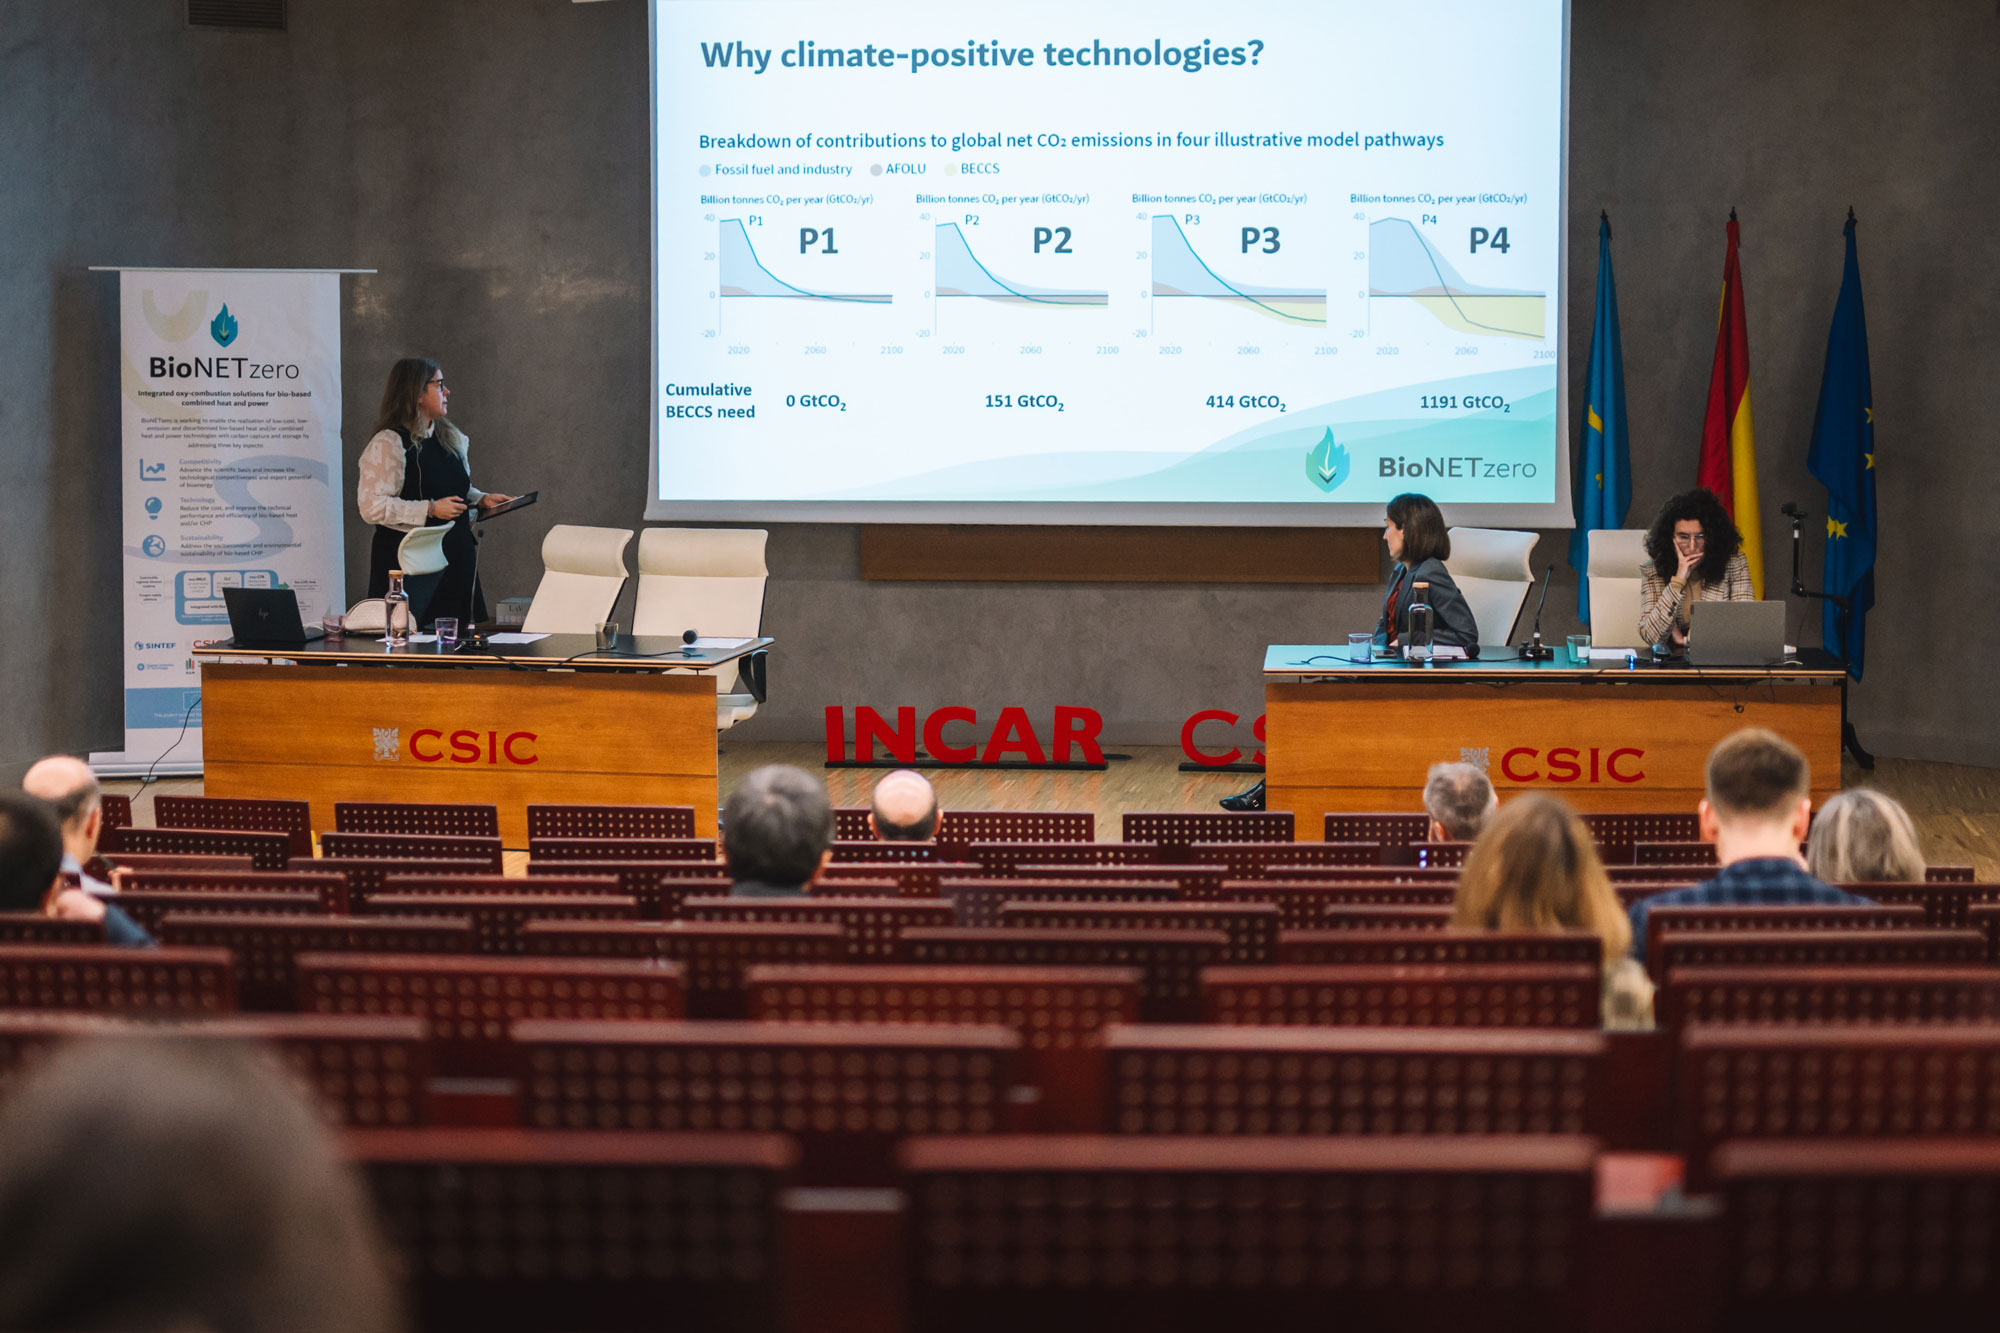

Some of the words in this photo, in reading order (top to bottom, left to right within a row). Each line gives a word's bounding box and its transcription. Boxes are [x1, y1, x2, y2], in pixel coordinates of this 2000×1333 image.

[701, 40, 771, 74] Why
[781, 39, 1035, 74] climate-positive
[1044, 39, 1264, 73] technologies?
[699, 133, 791, 148] Breakdown
[795, 133, 813, 148] of
[816, 133, 927, 148] contributions
[930, 135, 947, 148] to
[951, 133, 1002, 151] global
[1006, 132, 1033, 148] net
[1071, 132, 1153, 148] emissions
[1157, 132, 1172, 148] in
[1176, 132, 1210, 148] four
[1214, 132, 1303, 148] illustrative
[1307, 132, 1360, 148] model
[1364, 132, 1445, 151] pathways
[715, 163, 748, 176] Fossil
[751, 163, 773, 176] fuel
[776, 163, 799, 176] and
[802, 163, 853, 178] industry
[886, 162, 927, 175] AFOLU
[961, 162, 1000, 175] BECCS
[700, 193, 730, 203] Billion
[732, 195, 764, 203] tonnes
[787, 196, 802, 205] per
[804, 196, 824, 205] year
[916, 193, 945, 203] Billion
[947, 195, 979, 203] tonnes
[1002, 196, 1018, 205] per
[1019, 196, 1039, 205] year
[1132, 193, 1162, 203] Billion
[1164, 195, 1196, 203] tonnes
[1218, 196, 1234, 205] per
[1236, 196, 1257, 205] year
[1350, 193, 1380, 203] Billion
[1382, 195, 1416, 203] tonnes
[1437, 196, 1454, 205] per
[1456, 196, 1476, 205] year
[703, 214, 715, 222] 40
[748, 215, 763, 226] P1
[919, 213, 931, 221] 40
[965, 215, 980, 226] P2
[1136, 212, 1148, 220] 40
[1185, 214, 1201, 225] P3
[1353, 212, 1366, 220] 40
[1422, 214, 1438, 225] P4
[799, 227, 839, 254] P1
[1033, 227, 1073, 254] P2
[1241, 227, 1281, 254] P3
[1469, 227, 1511, 254] P4
[703, 252, 715, 260] 20
[919, 252, 931, 260] 20
[1136, 252, 1148, 260] 20
[1353, 252, 1366, 260] 20
[727, 347, 750, 355] 2020
[804, 347, 827, 355] 2060
[880, 347, 903, 355] 2100
[942, 347, 965, 355] 2020
[1020, 347, 1042, 355] 2060
[1096, 347, 1119, 355] 2100
[1159, 347, 1182, 355] 2020
[1237, 347, 1260, 355] 2060
[1314, 347, 1338, 355] 2100
[1376, 347, 1400, 355] 2020
[1455, 347, 1478, 355] 2060
[1533, 350, 1556, 359] 2100
[149, 357, 300, 380] BioNETzero
[138, 390, 175, 398] Integrated
[176, 390, 232, 398] oxy-combustion
[232, 390, 265, 398] solutions
[265, 390, 276, 398] for
[277, 390, 312, 398] bio-based
[666, 383, 752, 397] Cumulative
[181, 400, 216, 408] combined
[217, 400, 232, 408] heat
[233, 400, 247, 408] and
[247, 400, 270, 408] power
[786, 395, 795, 408] 0
[985, 395, 1013, 408] 151
[1206, 395, 1235, 408] 414
[1420, 395, 1458, 408] 1191
[666, 405, 713, 419] BECCS
[717, 405, 755, 419] need
[1378, 456, 1537, 479] BioNETzero
[825, 705, 1106, 764] INCAR
[409, 729, 539, 765] CSIC
[1501, 748, 1645, 783] CSIC
